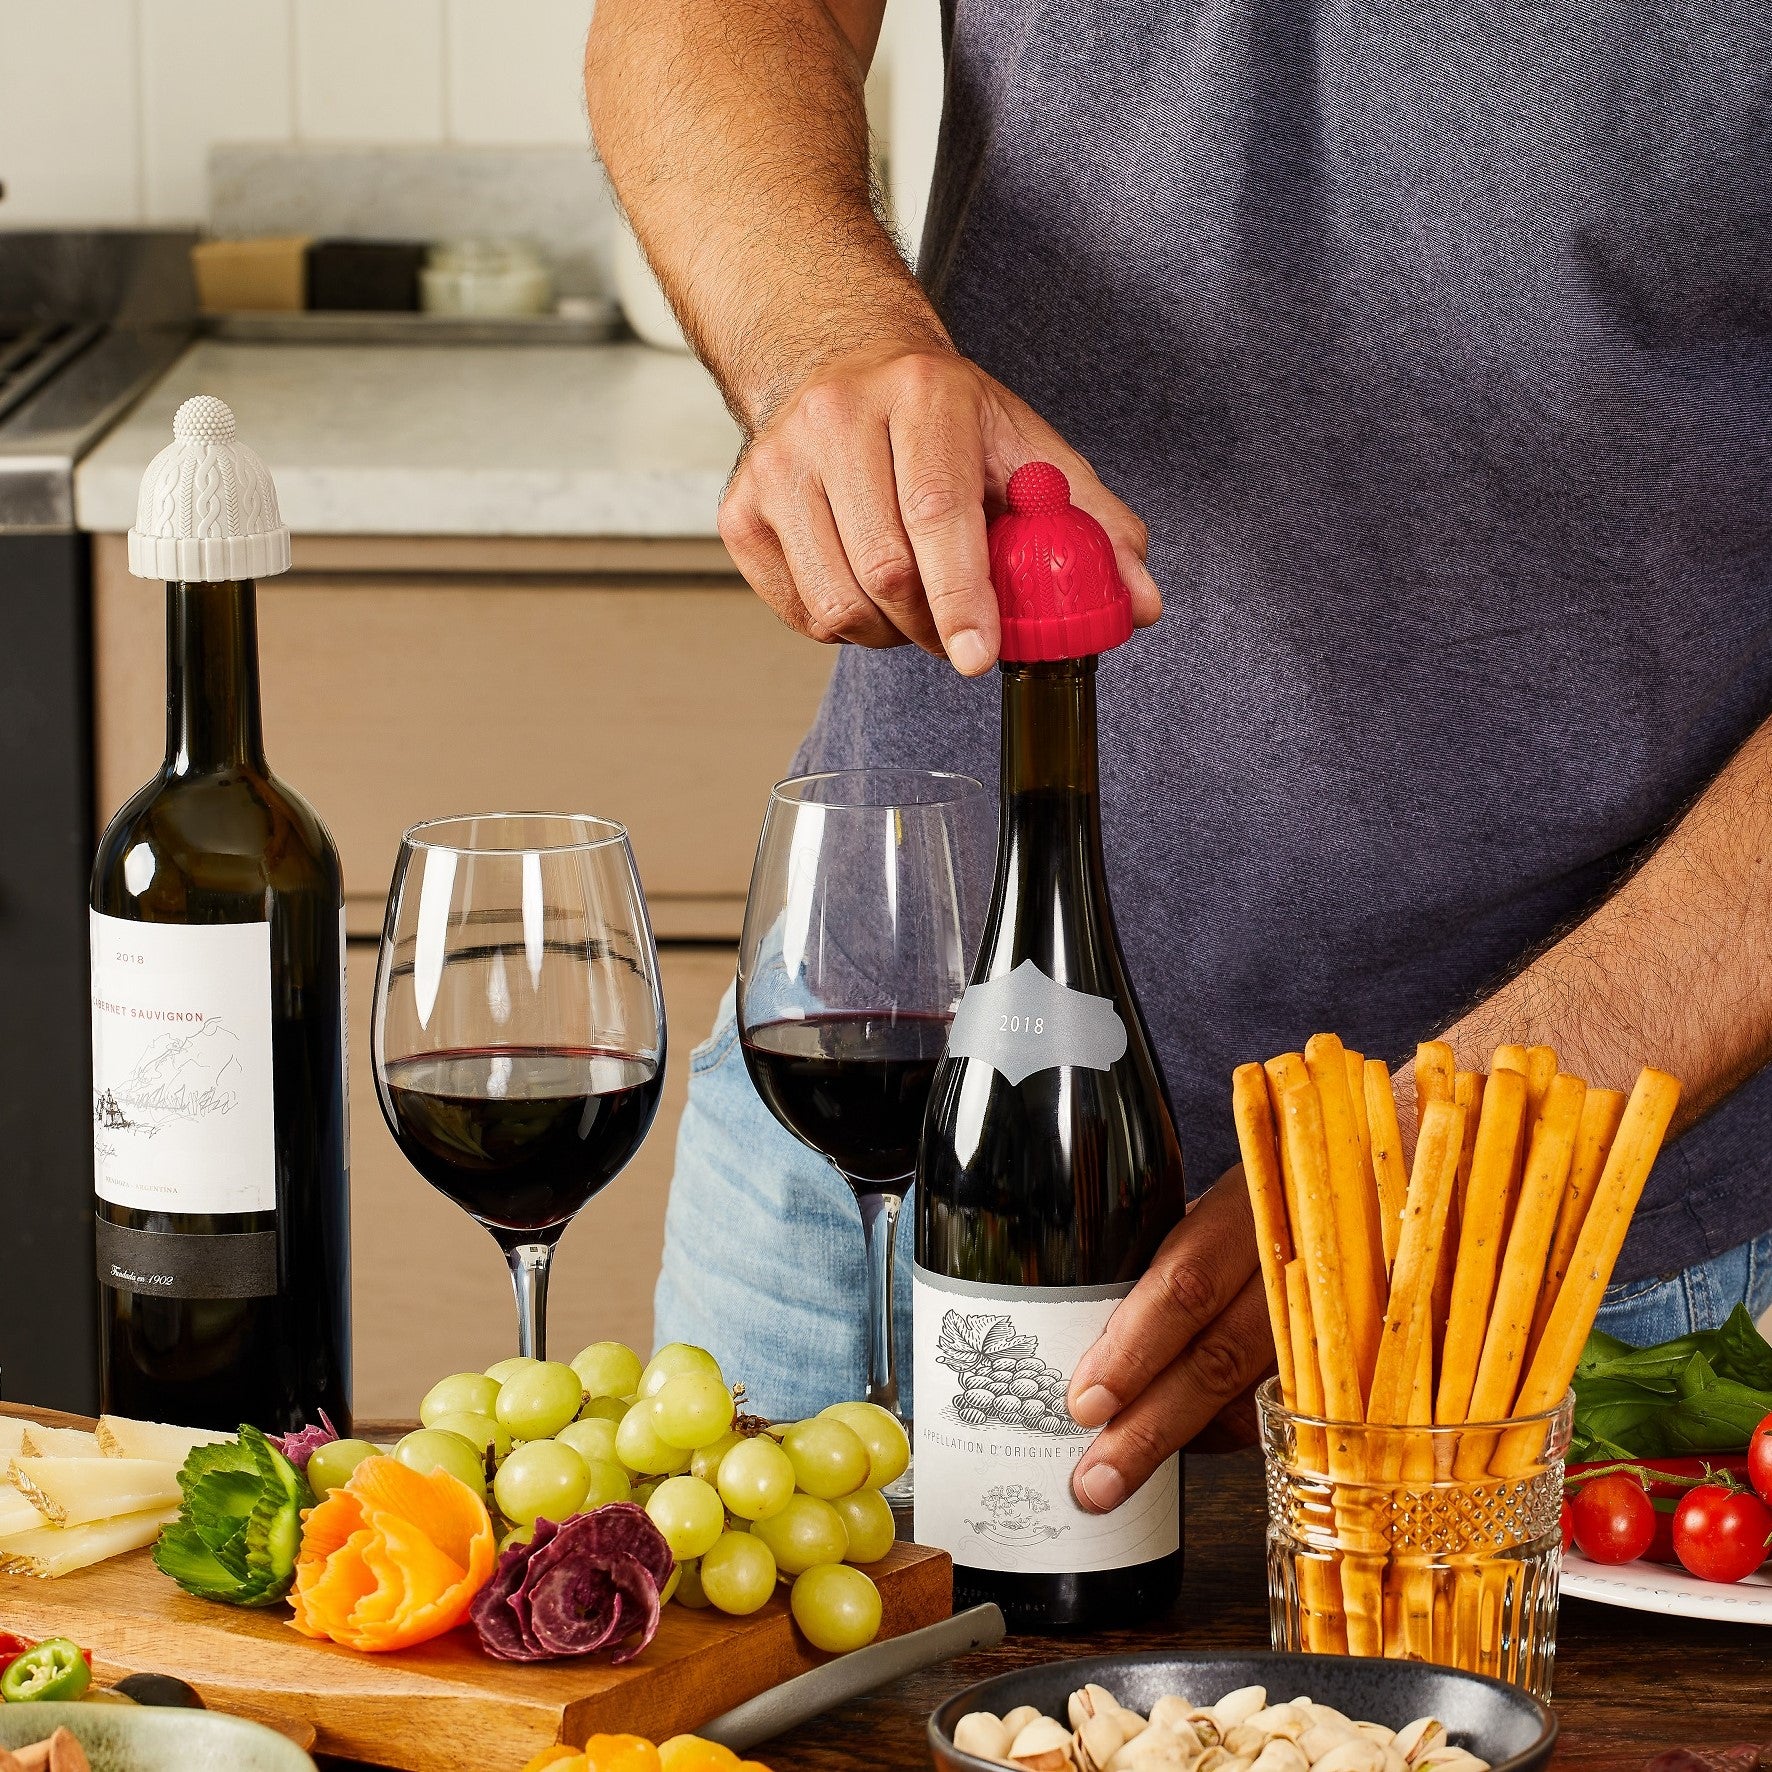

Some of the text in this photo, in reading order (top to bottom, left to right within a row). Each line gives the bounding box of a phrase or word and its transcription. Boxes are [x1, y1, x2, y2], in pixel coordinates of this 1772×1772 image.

[116, 952, 144, 964] 2018
[131, 1009, 204, 1021] SAUVIGNON
[1000, 1015, 1043, 1034] 2018
[136, 1184, 178, 1194] ARGENTINA
[148, 1274, 174, 1285] 1902
[924, 1428, 983, 1454] APPELLATION
[990, 1444, 1062, 1458] D'ORIGINE
